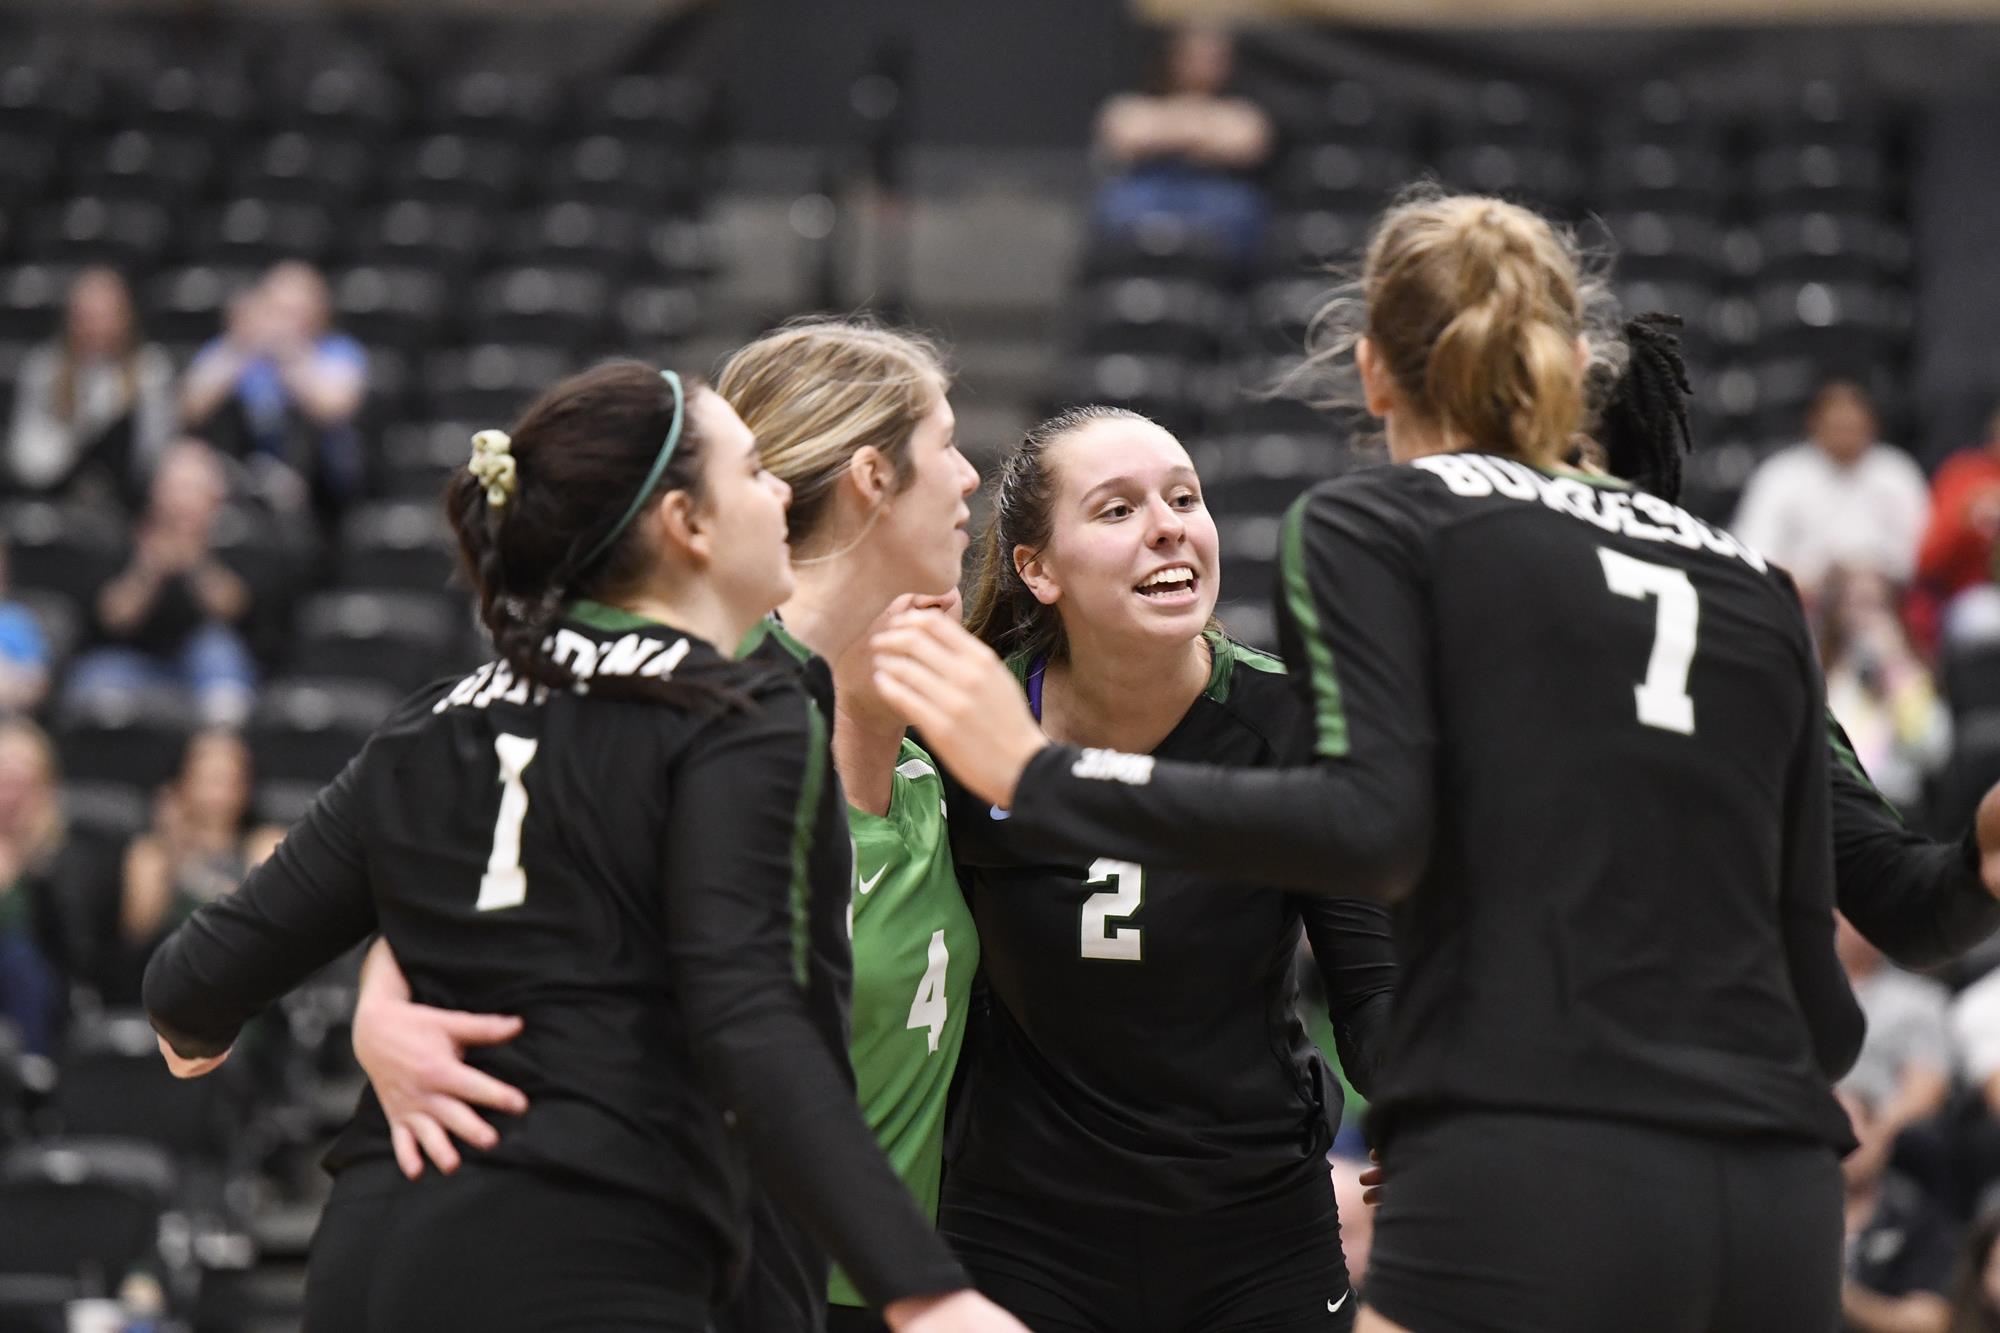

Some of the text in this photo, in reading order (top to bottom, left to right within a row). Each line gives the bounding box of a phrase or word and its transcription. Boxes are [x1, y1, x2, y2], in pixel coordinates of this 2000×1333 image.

[1597, 546, 1699, 736] 7
[476, 732, 538, 912] 1
[1080, 857, 1142, 961] 2
[906, 929, 949, 1056] 4
